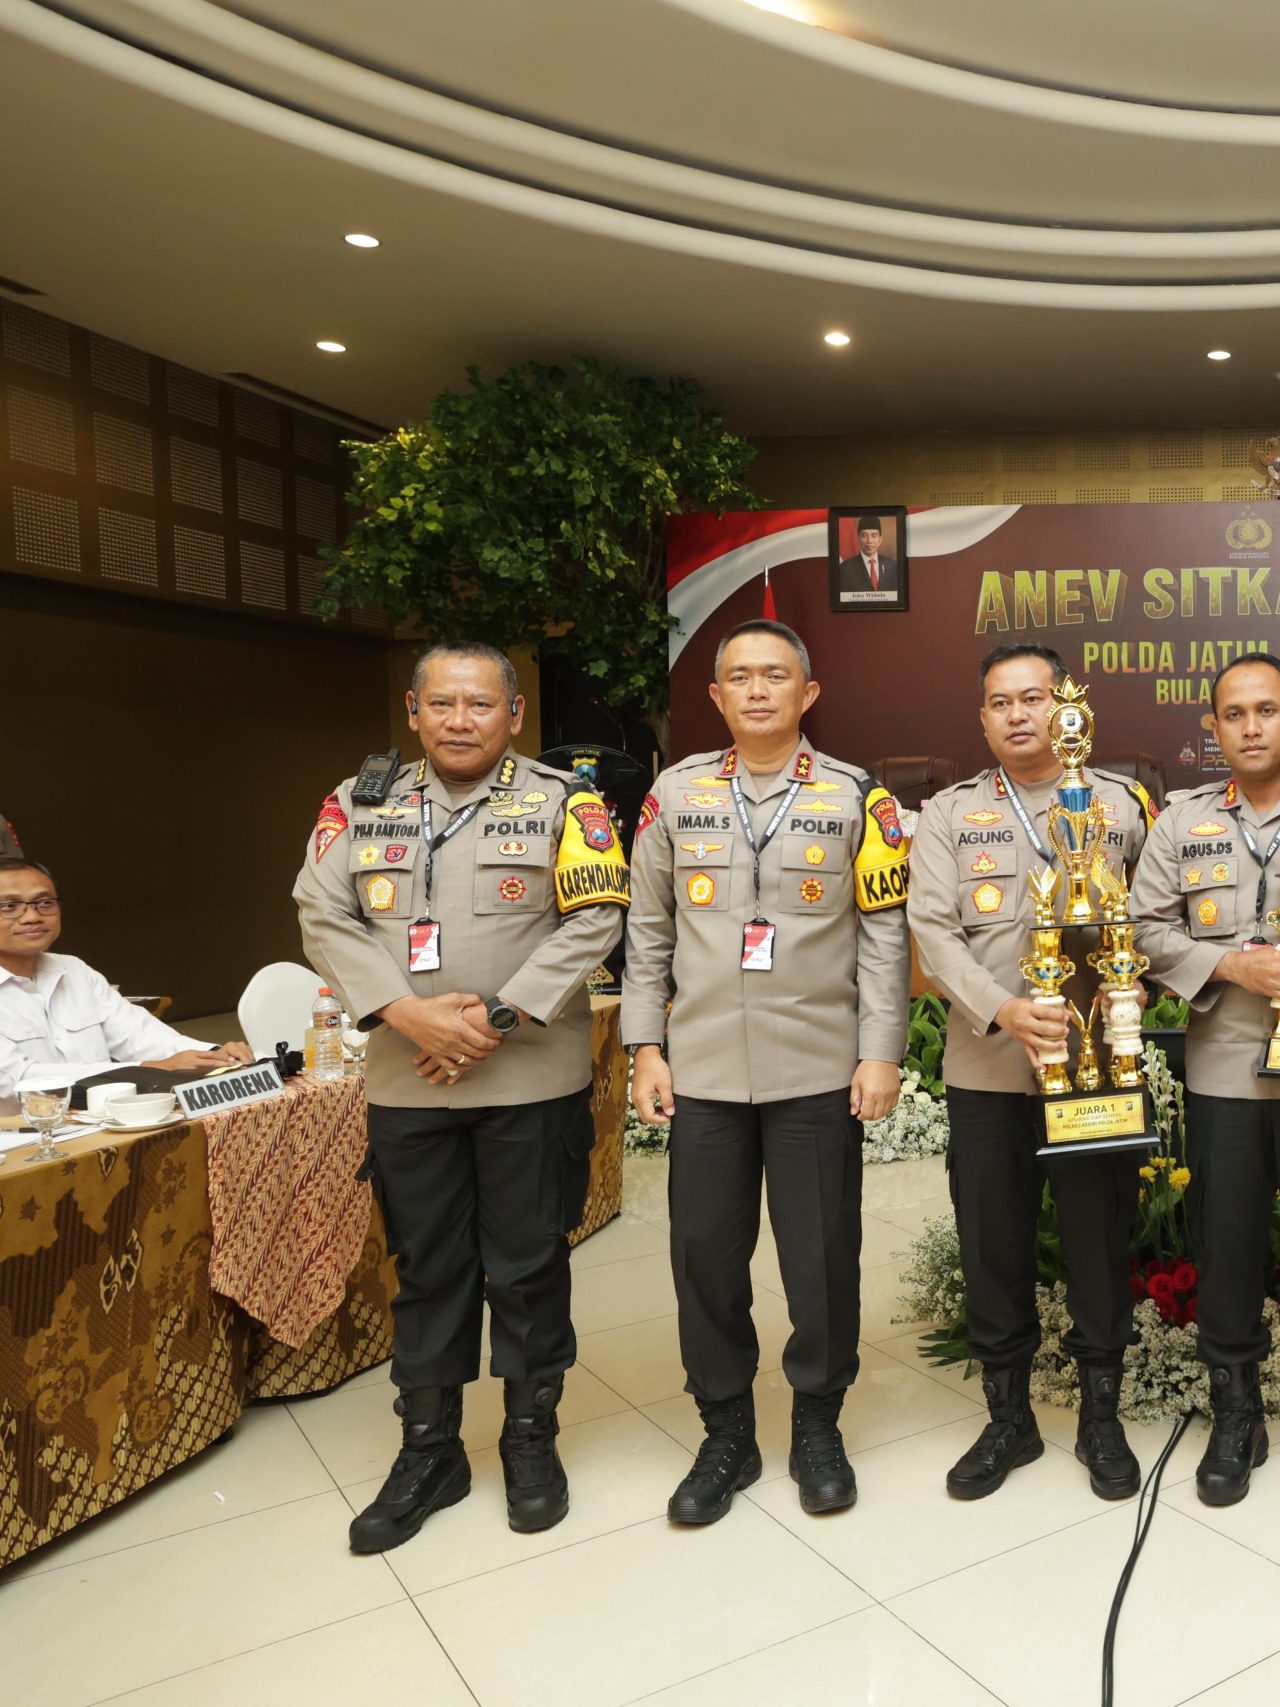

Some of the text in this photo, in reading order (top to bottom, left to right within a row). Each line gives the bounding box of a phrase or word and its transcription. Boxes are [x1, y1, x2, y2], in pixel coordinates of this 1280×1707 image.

[974, 568, 1122, 635] ANEV
[1083, 640, 1175, 674] POLDA
[1156, 678, 1216, 706] BULA
[578, 807, 606, 816] POLDA
[484, 820, 546, 836] POLRI
[790, 817, 843, 836] POLRI
[957, 829, 1014, 847] AGUNG
[1181, 840, 1233, 859] AGUS.DS
[182, 1069, 280, 1112] KARORENA
[1074, 1103, 1116, 1116] JUARA 1
